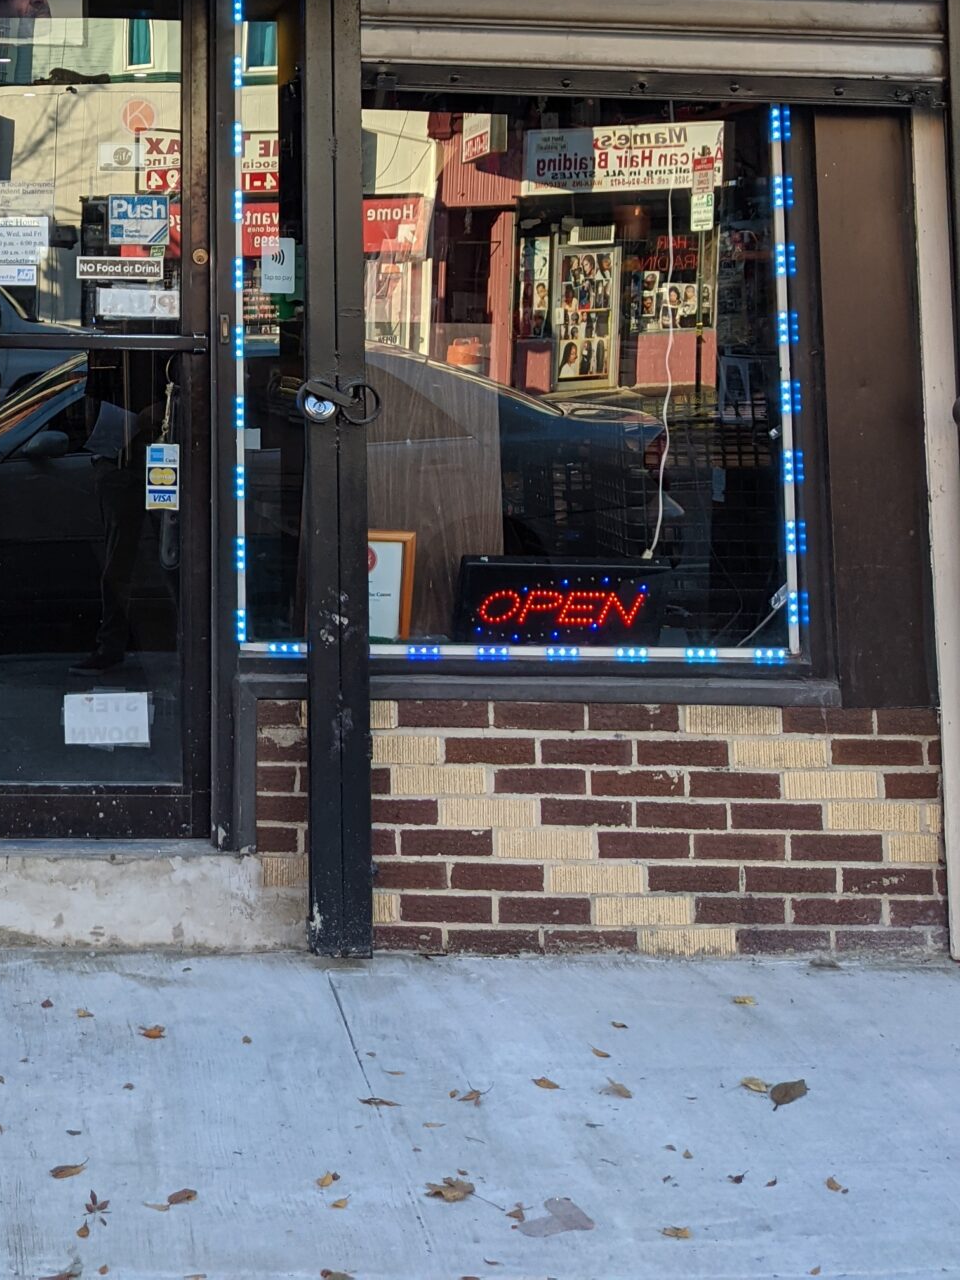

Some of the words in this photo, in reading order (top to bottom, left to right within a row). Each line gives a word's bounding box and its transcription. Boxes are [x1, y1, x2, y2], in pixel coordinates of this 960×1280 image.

[112, 199, 166, 219] Push
[79, 263, 95, 272] NO
[96, 263, 122, 273] Food
[123, 265, 134, 273] or
[134, 263, 160, 273] Drink
[152, 494, 172, 503] VISA
[477, 589, 646, 627] OPEN
